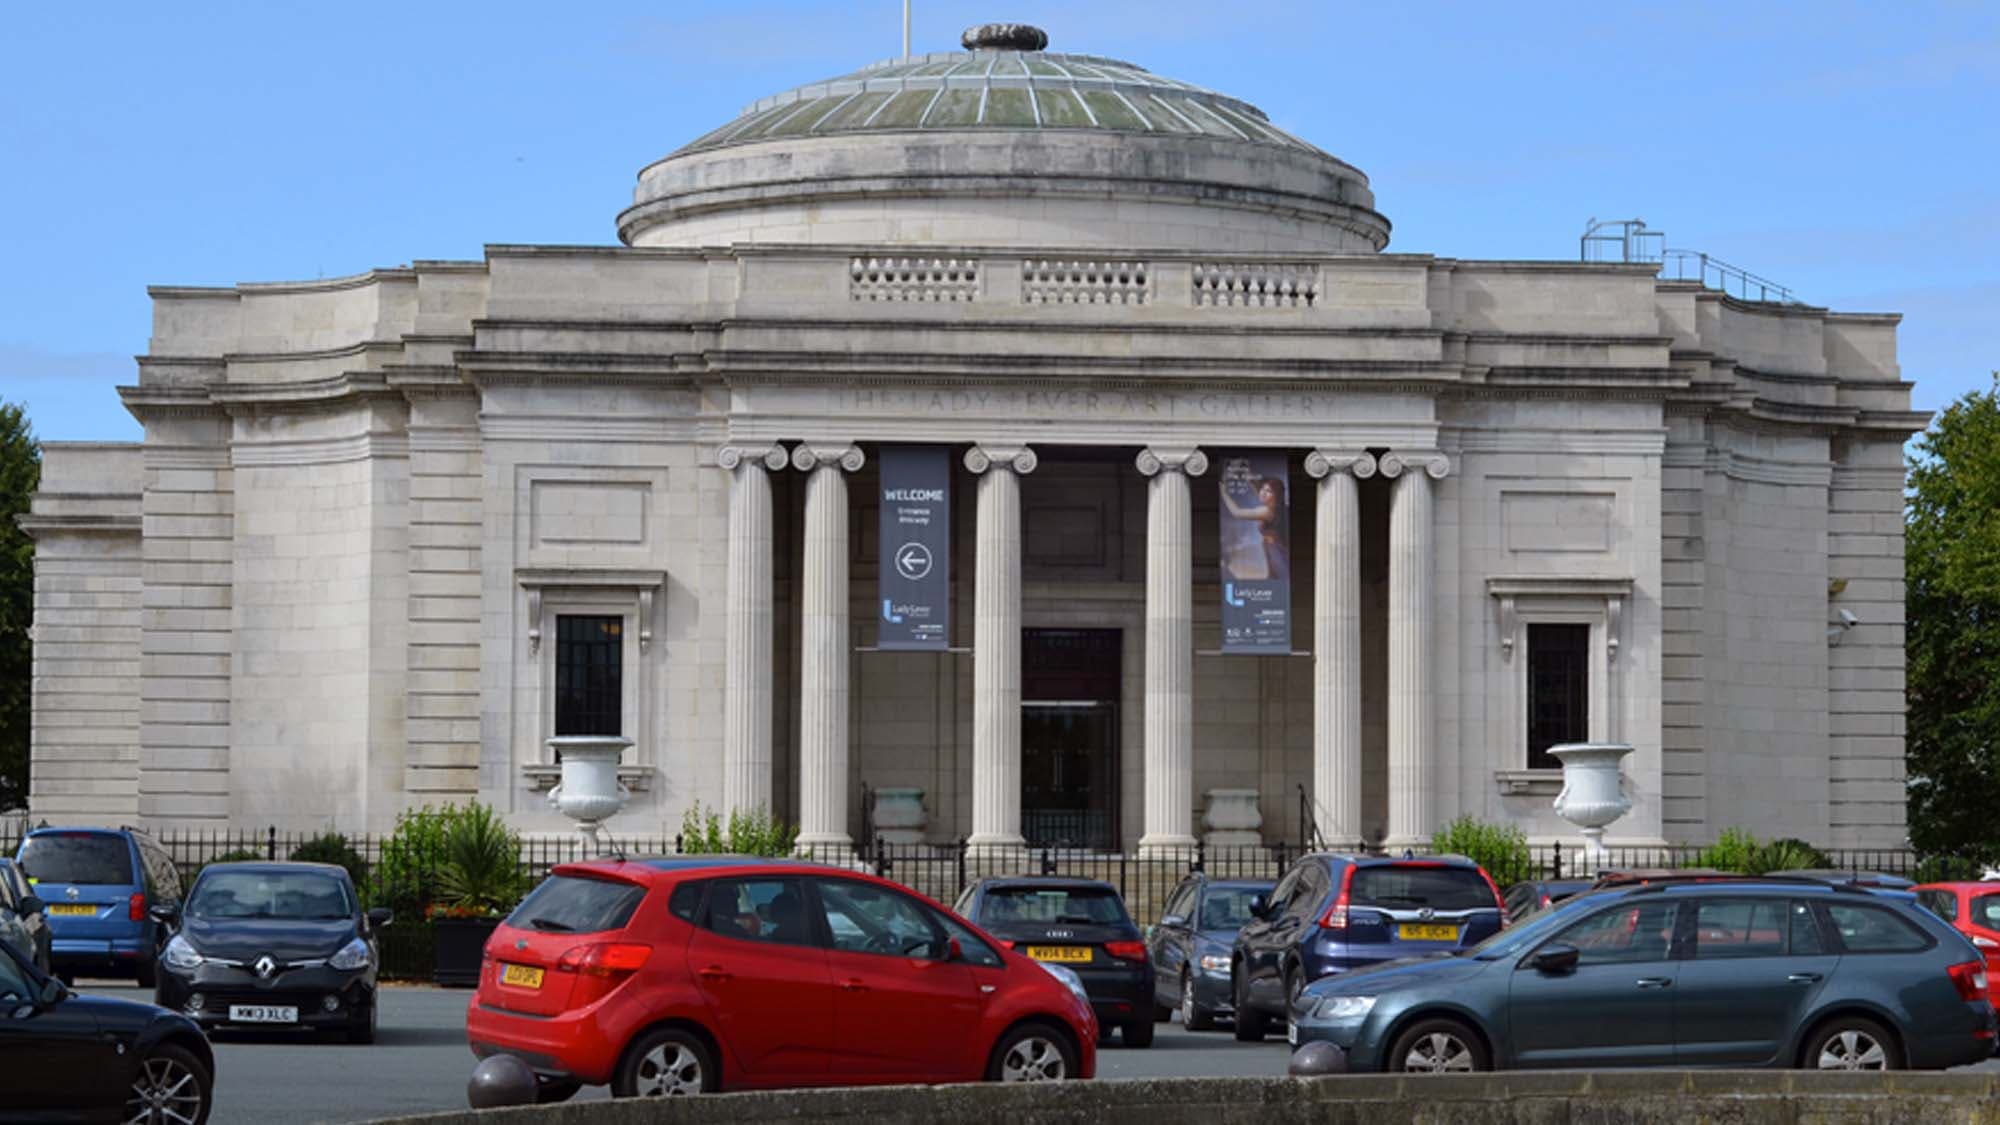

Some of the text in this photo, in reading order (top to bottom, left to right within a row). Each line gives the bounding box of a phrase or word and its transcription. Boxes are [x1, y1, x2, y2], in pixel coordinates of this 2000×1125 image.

[837, 390, 1335, 417] THE LADY LEVER ART GALLERY
[884, 489, 944, 501] WELCOME
